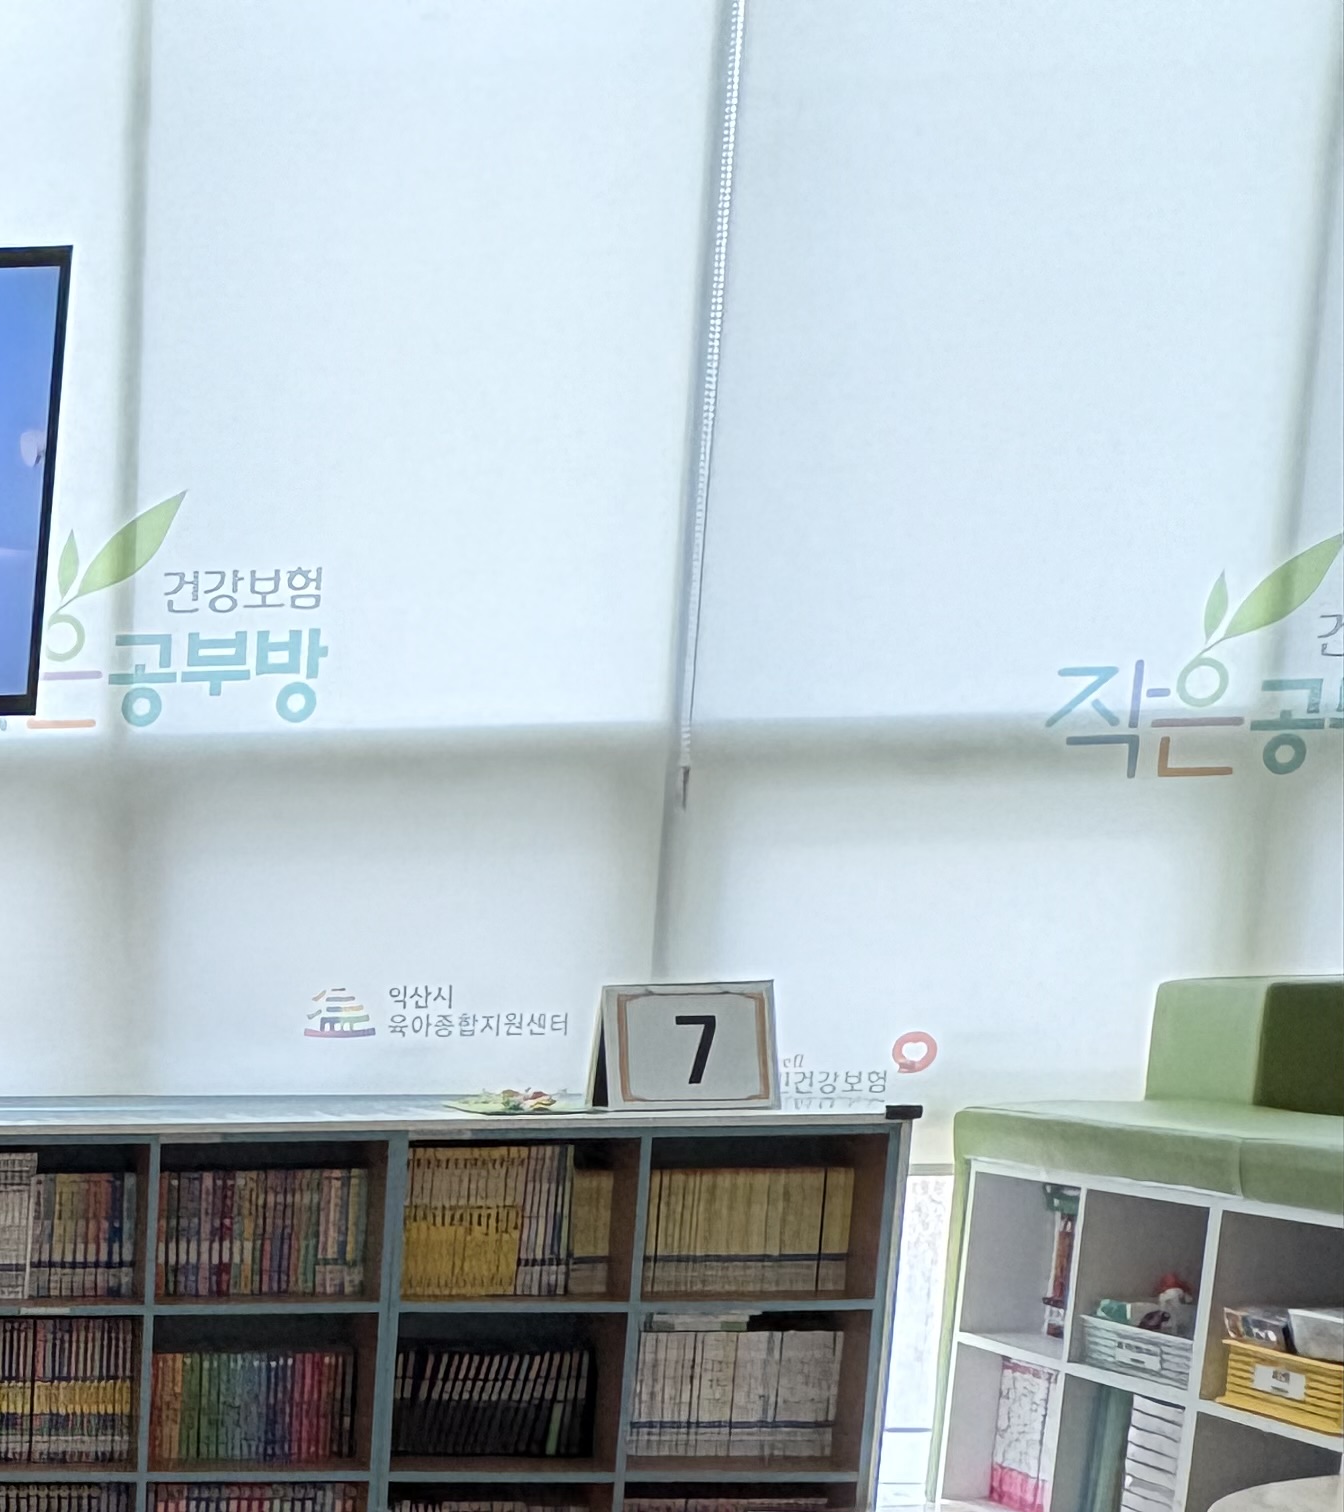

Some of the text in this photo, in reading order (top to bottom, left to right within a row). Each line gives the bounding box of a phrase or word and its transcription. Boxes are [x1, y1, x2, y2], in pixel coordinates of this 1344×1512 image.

[163, 565, 323, 614] 건강보험
[388, 984, 453, 1009] 익산시
[387, 1012, 569, 1038] 육아종합지원센터
[675, 1014, 717, 1085] 7
